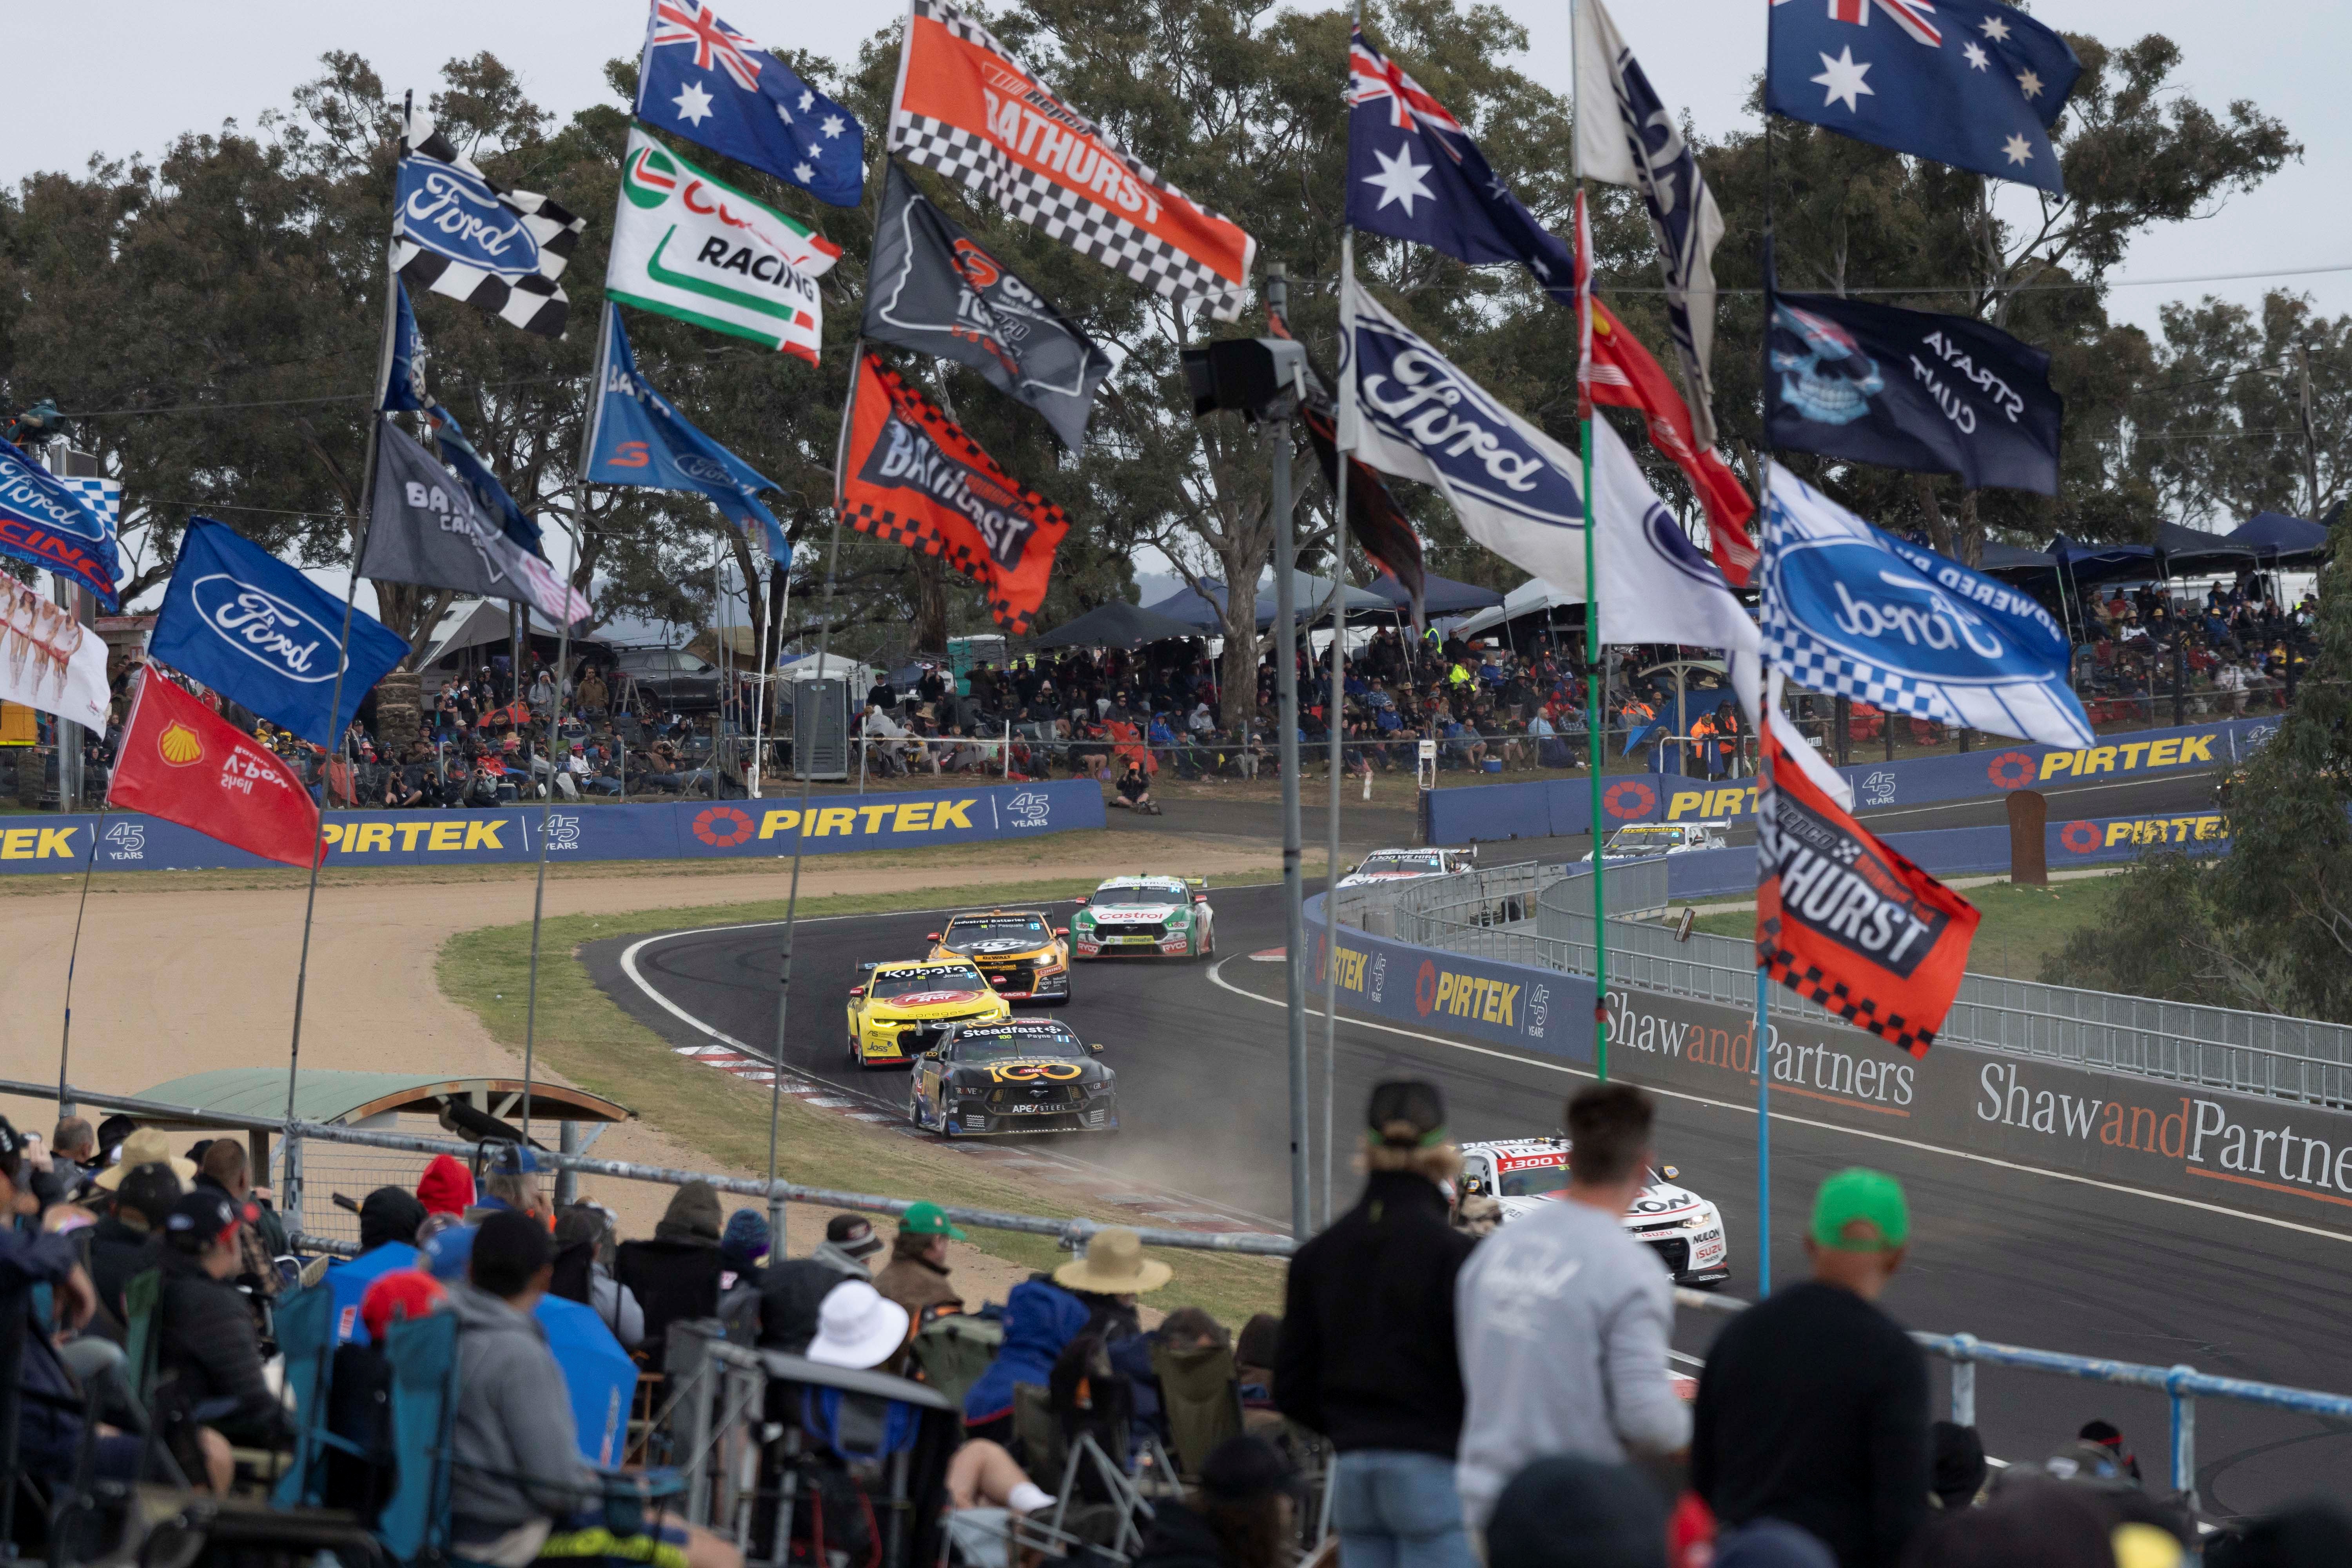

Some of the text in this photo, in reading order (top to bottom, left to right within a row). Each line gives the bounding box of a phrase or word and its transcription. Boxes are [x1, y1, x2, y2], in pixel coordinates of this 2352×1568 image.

[406, 172, 520, 256] Ford
[697, 236, 814, 303] RACING
[1362, 348, 1544, 494] Ford
[0, 461, 81, 524] Ford
[216, 591, 320, 672] Ford
[2039, 734, 2218, 781] PIRTEK
[1862, 772, 1896, 797] 45
[1006, 792, 1049, 819] 45
[1667, 787, 1759, 820] PIRT
[1866, 796, 1895, 805] YEARS
[538, 815, 580, 842] 45
[758, 799, 978, 840] PIRTEK
[1011, 818, 1049, 828] YEARS
[106, 822, 145, 851] 45
[110, 851, 143, 860] YEARS
[1078, 942, 1098, 953] RYCO
[1162, 941, 1187, 951] RYCO
[1322, 946, 1368, 993] RTEK
[1372, 953, 1386, 992] 45
[1371, 991, 1382, 1003] YEARS
[1435, 971, 1521, 1027] PIRTEK
[1530, 984, 1550, 1026] 45
[963, 1026, 1044, 1038] Steadfast
[1528, 1025, 1544, 1038] YEARS
[867, 1042, 888, 1053] Joss
[1012, 1103, 1040, 1114] APEX
[1503, 1157, 1553, 1170] 1300
[1693, 1228, 1720, 1244] NULON
[1695, 1243, 1722, 1260] ISUZU
